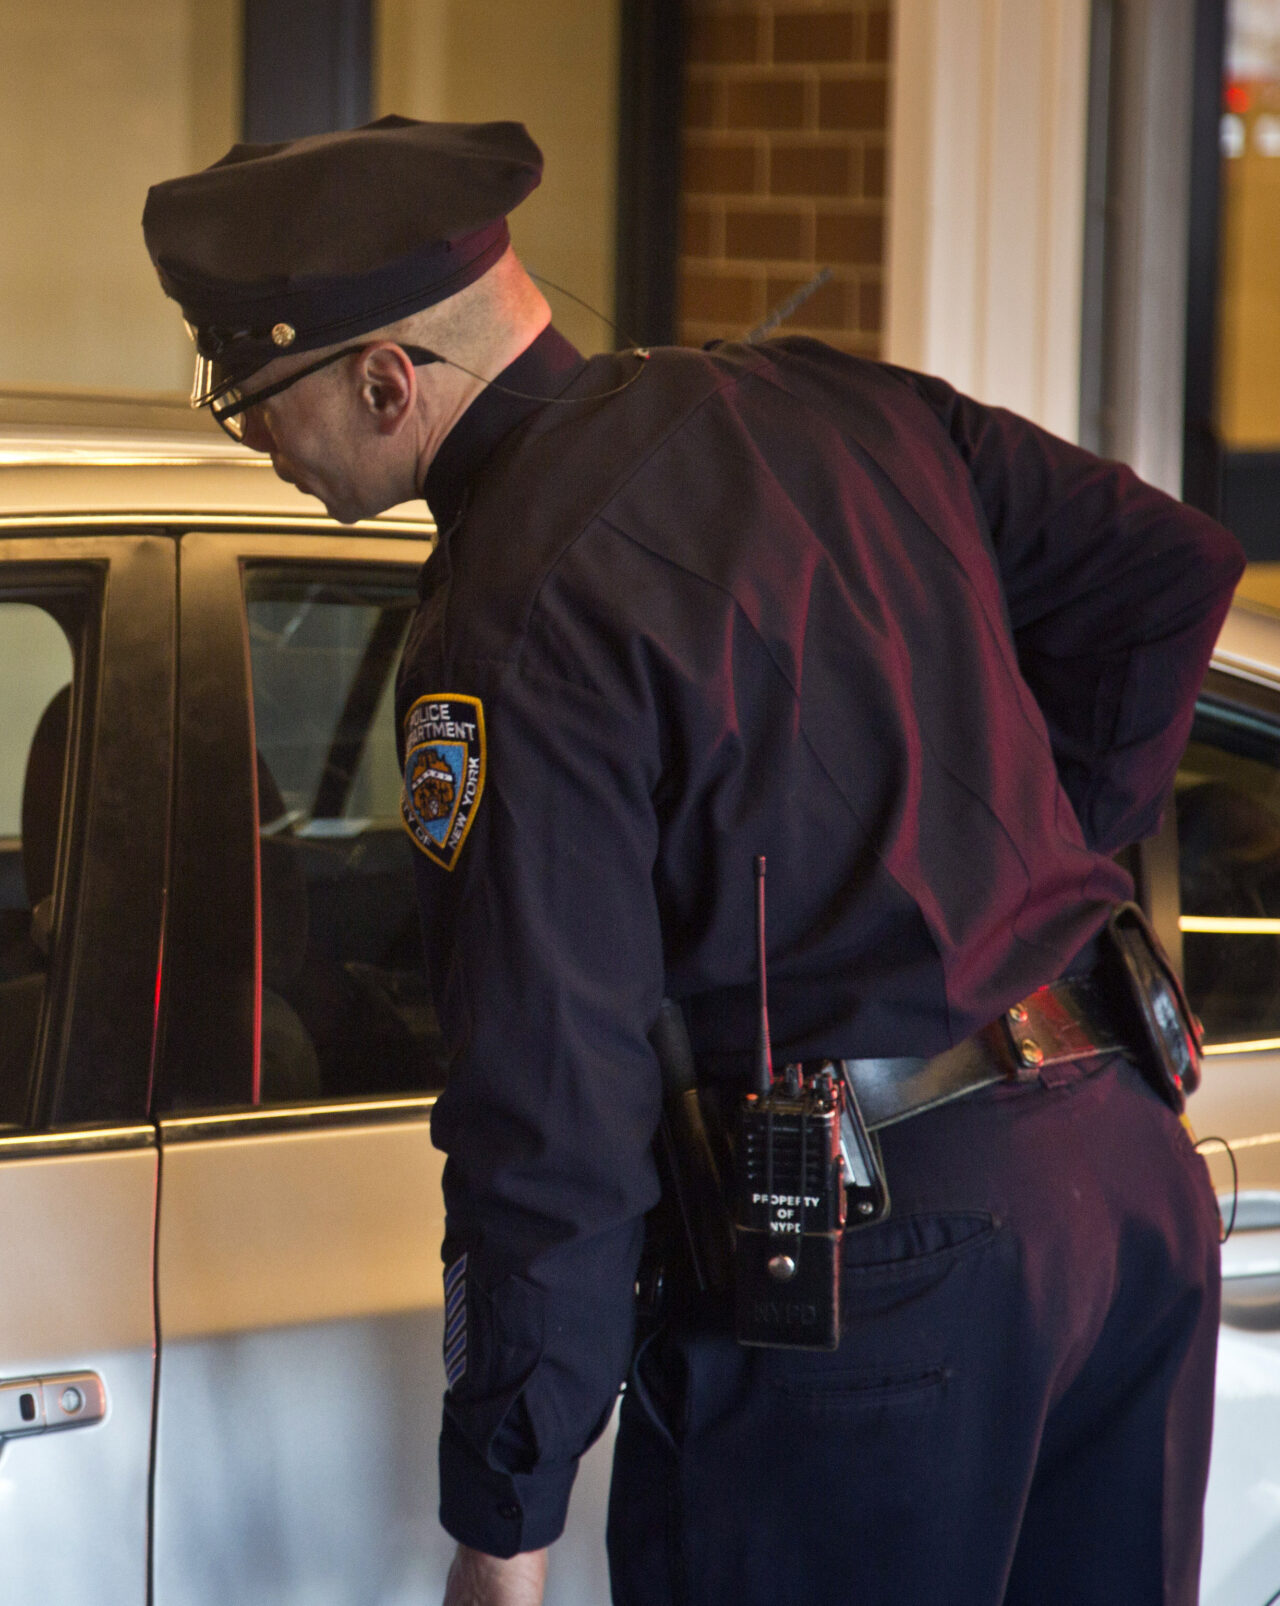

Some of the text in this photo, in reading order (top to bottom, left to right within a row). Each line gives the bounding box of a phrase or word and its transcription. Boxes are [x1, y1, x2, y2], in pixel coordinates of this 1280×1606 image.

[448, 811, 468, 850] NEW
[461, 757, 480, 806] YORK
[777, 1208, 795, 1219] OF
